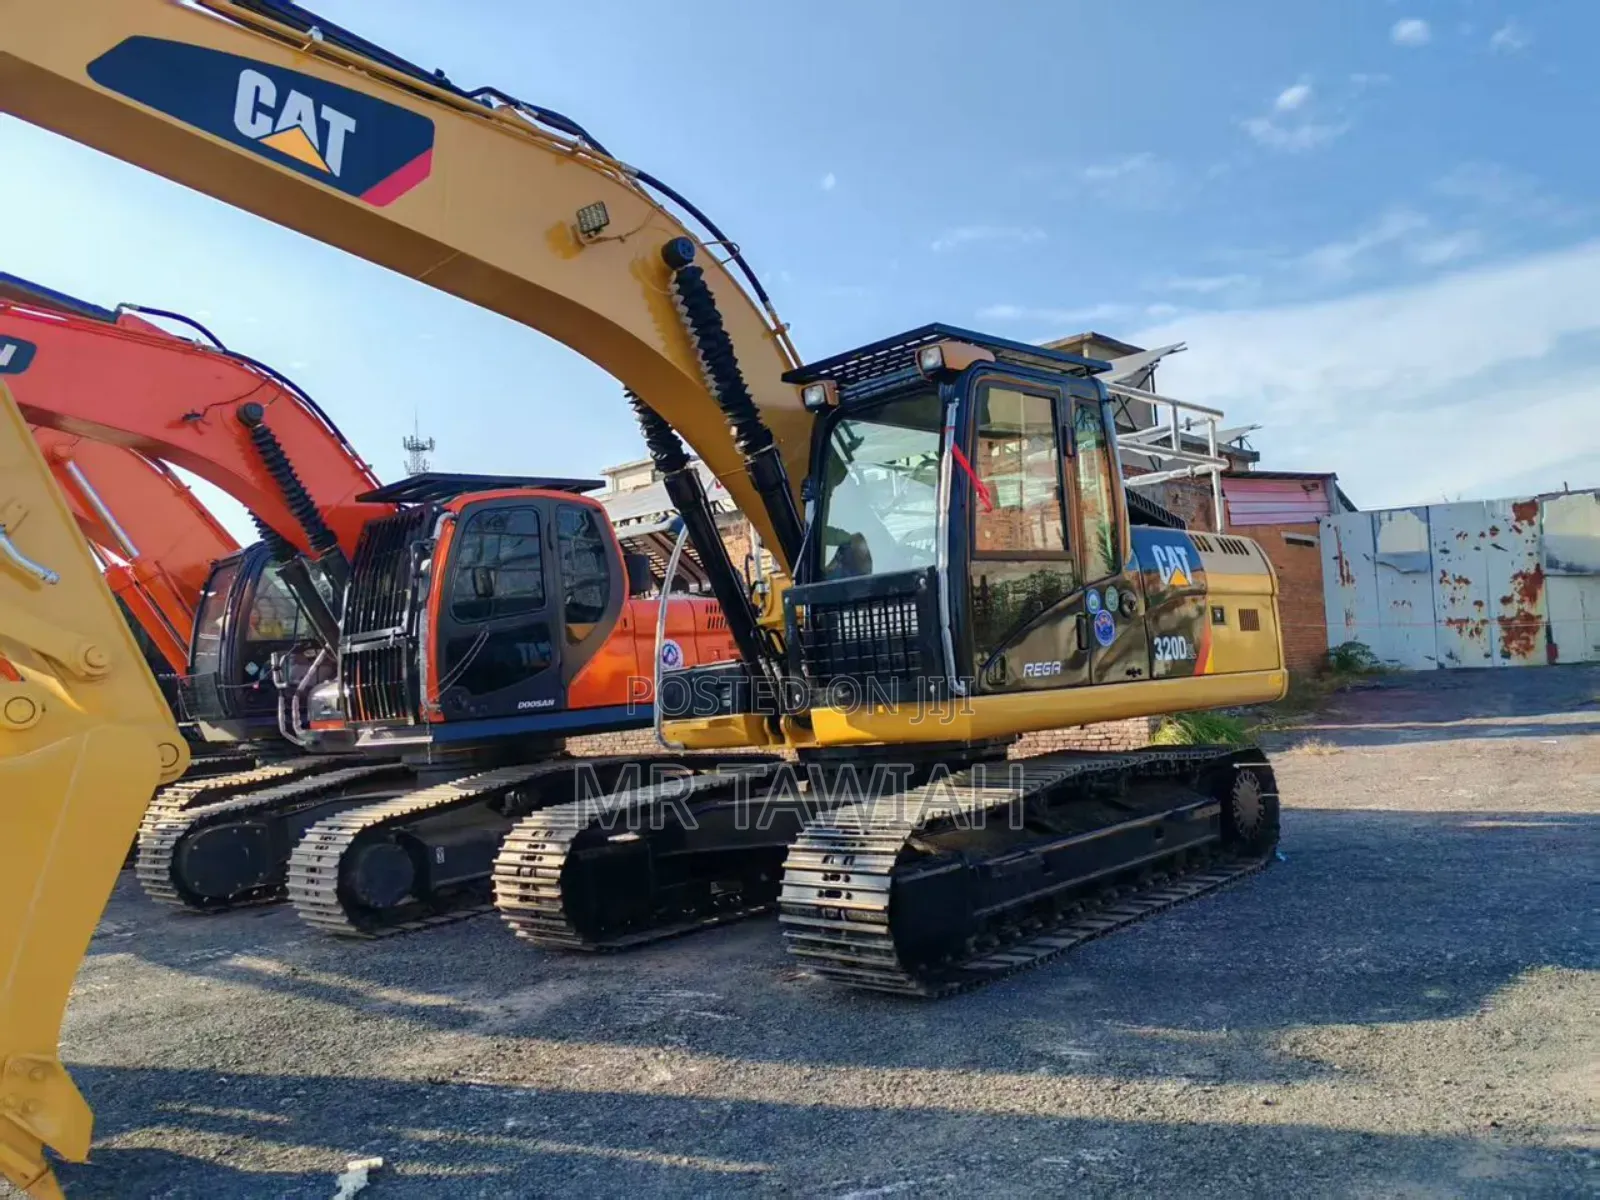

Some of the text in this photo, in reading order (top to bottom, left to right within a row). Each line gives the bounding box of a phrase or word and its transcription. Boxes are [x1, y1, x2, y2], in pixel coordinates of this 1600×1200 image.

[234, 69, 356, 178] CAT
[1151, 544, 1192, 585] CAT
[1154, 635, 1187, 661] 320D
[1023, 661, 1061, 678] REGA
[517, 698, 555, 710] DOOSAN
